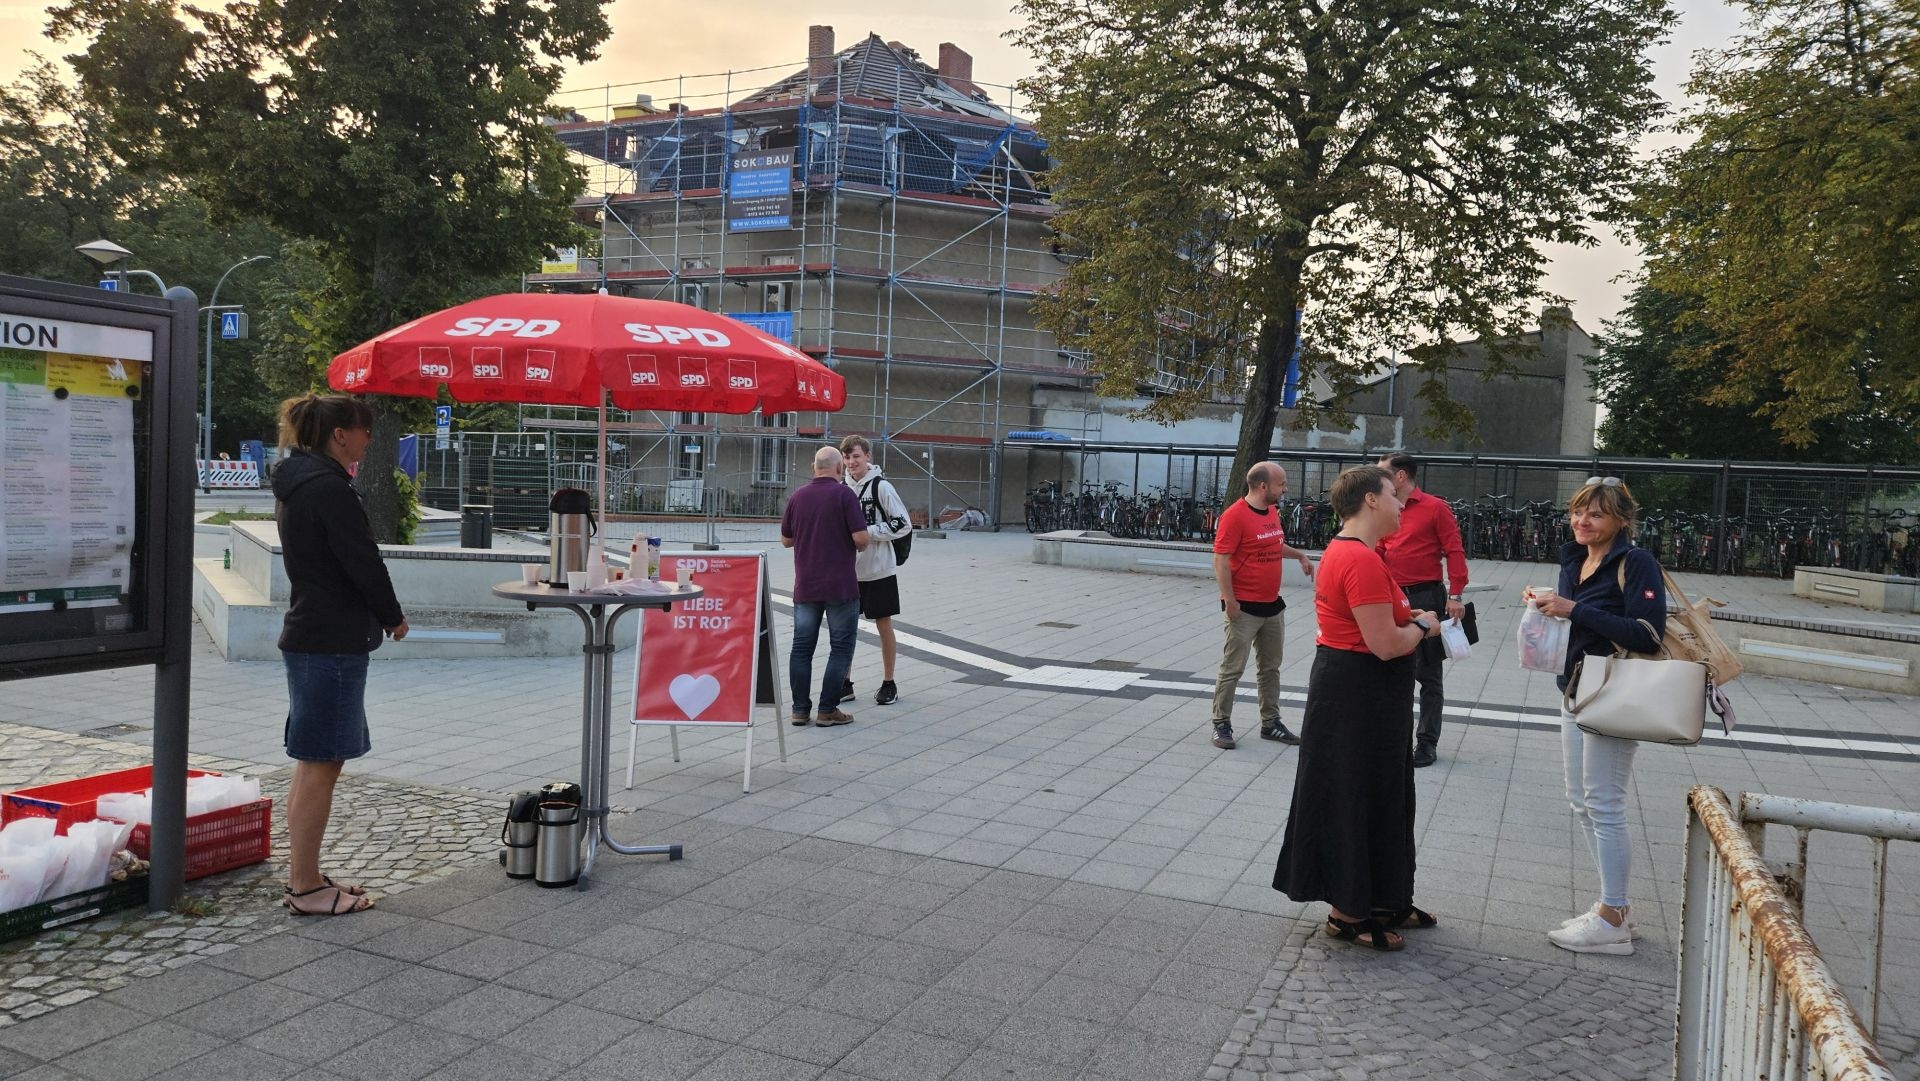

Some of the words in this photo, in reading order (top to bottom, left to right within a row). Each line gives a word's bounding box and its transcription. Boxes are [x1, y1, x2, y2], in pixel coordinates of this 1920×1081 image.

[444, 317, 561, 338] SPD
[0, 321, 58, 348] ION
[624, 323, 731, 347] SPD
[422, 364, 448, 376] SPD
[474, 364, 499, 376] SPD
[527, 367, 550, 379] SPD
[632, 372, 656, 384] SPD
[681, 374, 705, 385] SPD
[730, 376, 753, 388] SPD
[676, 558, 708, 573] SPD
[683, 599, 723, 611] LIEBE
[674, 615, 696, 629] IST
[700, 616, 731, 629] ROT
